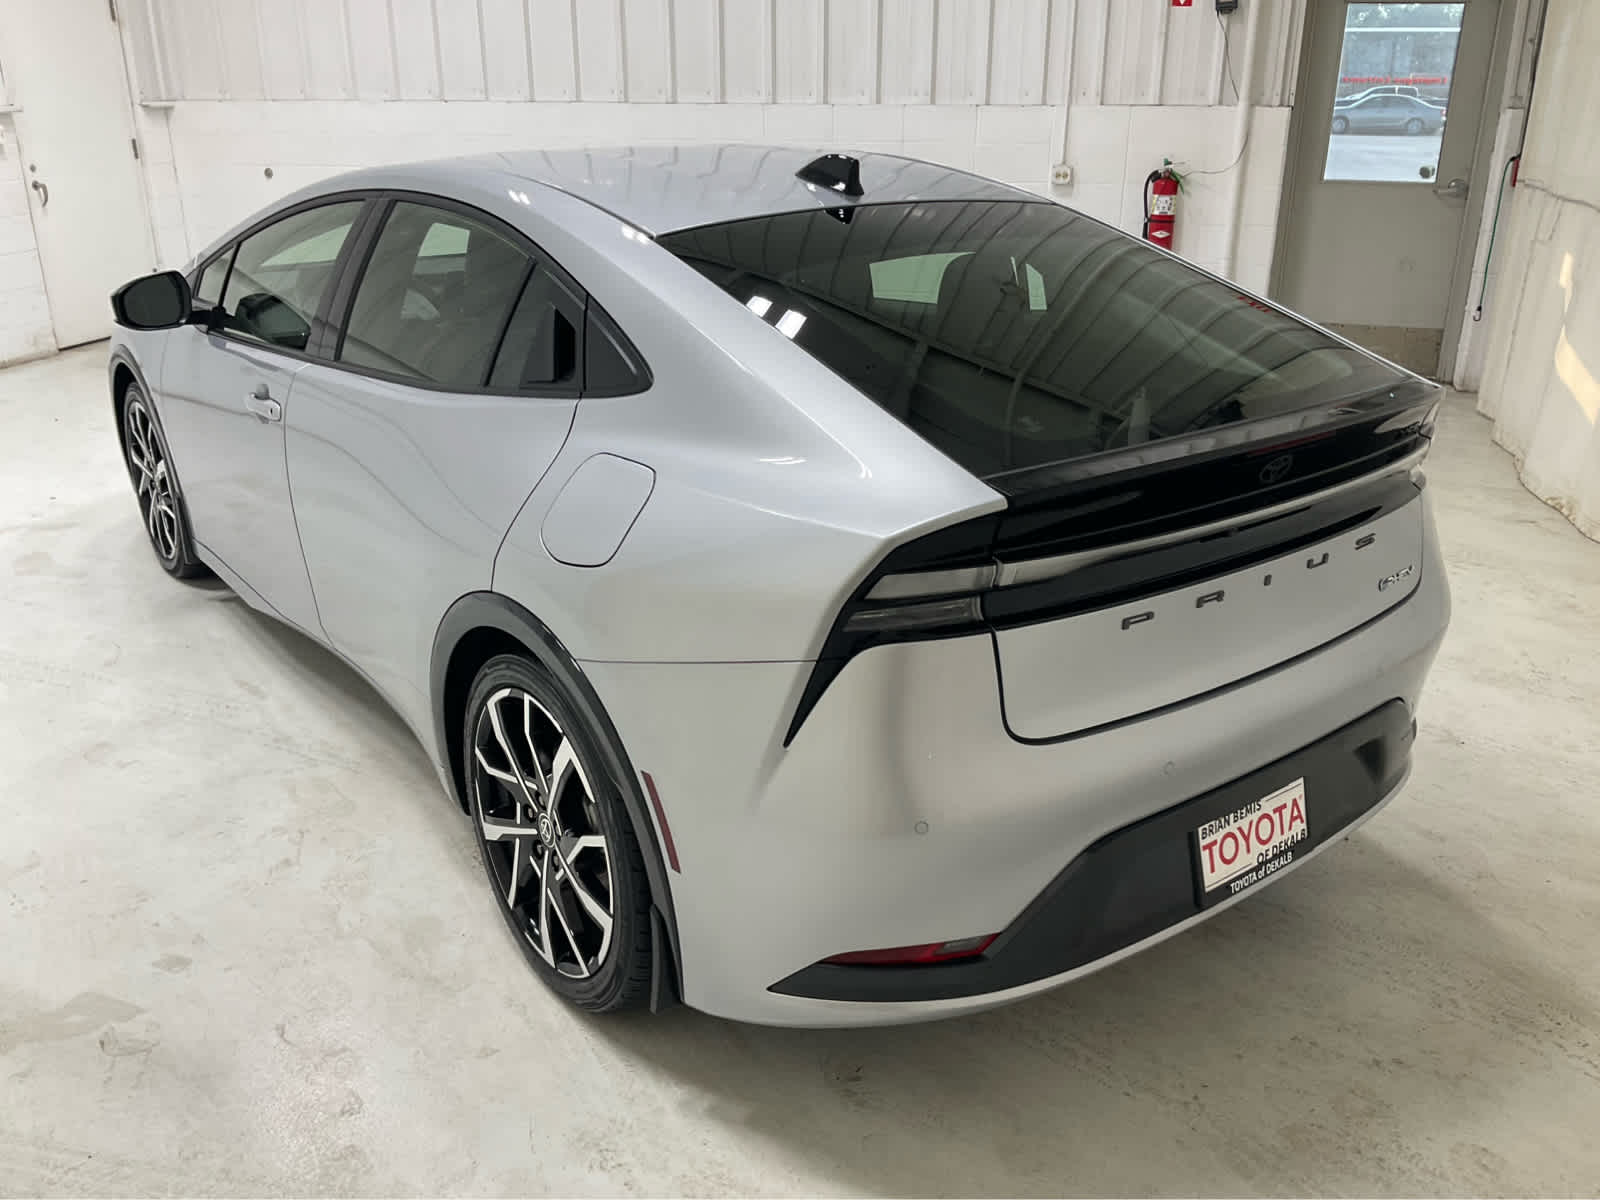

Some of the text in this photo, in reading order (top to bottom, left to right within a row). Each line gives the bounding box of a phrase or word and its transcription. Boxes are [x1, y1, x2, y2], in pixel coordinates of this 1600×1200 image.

[1121, 533, 1376, 630] PRIUS
[1201, 801, 1262, 840] BRIAN BEMIS
[1202, 797, 1305, 874] TOYOTA
[1257, 828, 1306, 865] OF DEKALB
[1230, 851, 1293, 893] TOYOTA of DEKALB
